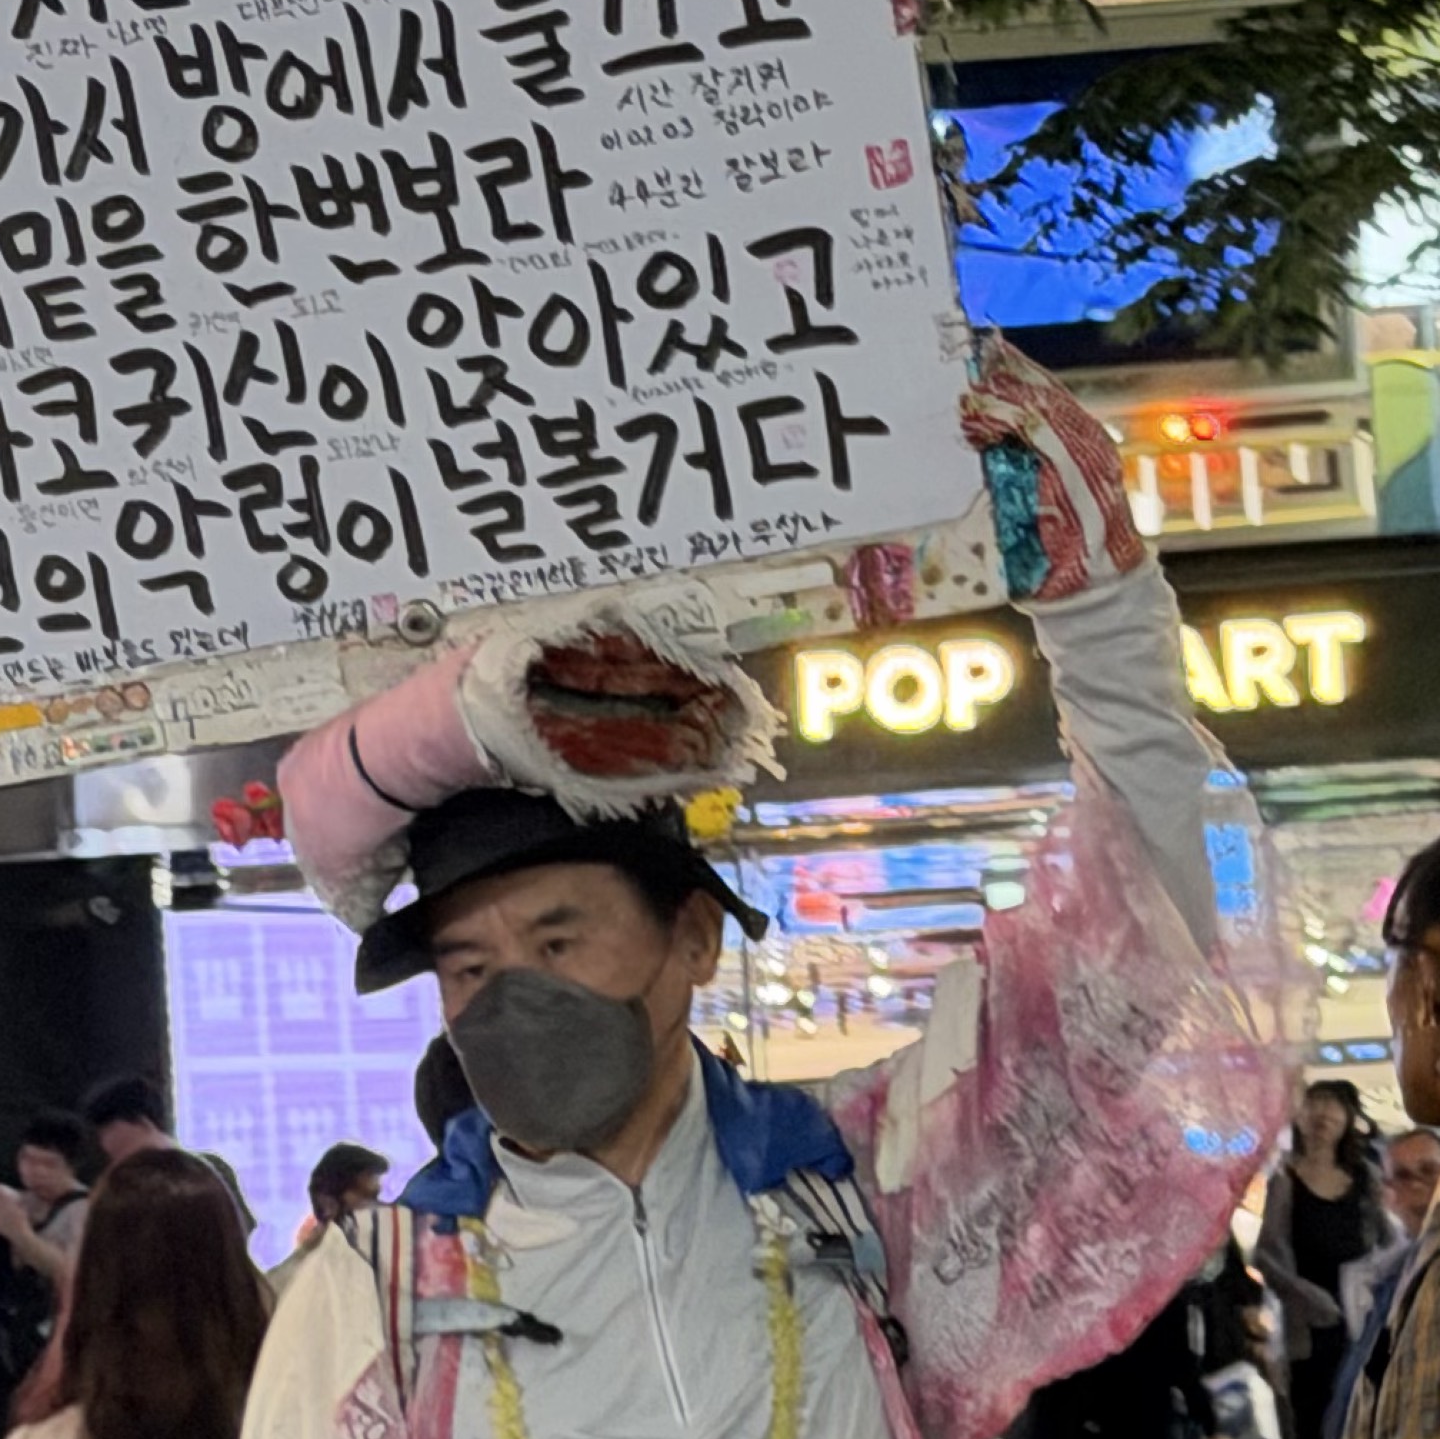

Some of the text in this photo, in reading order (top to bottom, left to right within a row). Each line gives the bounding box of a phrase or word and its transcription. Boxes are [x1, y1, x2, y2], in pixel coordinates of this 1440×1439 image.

[116, 454, 429, 614] 악령이
[795, 611, 1364, 743] POP ART
